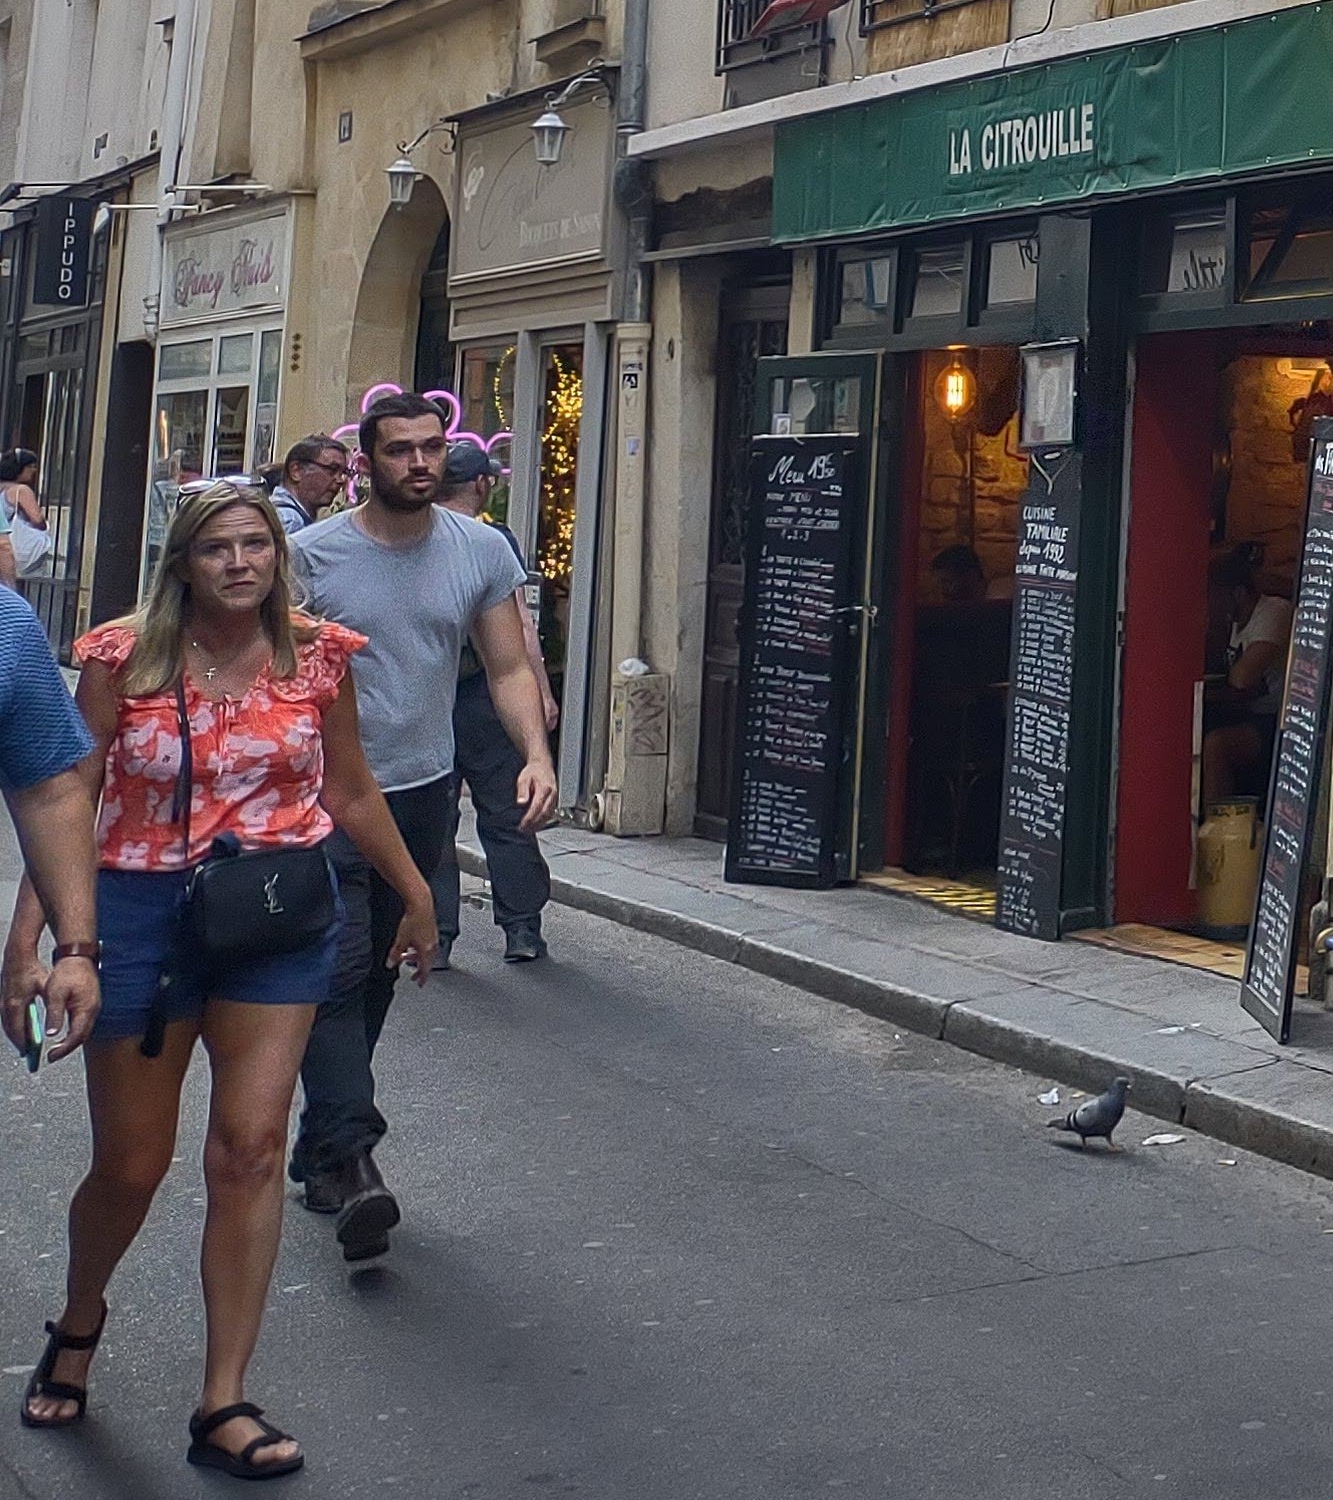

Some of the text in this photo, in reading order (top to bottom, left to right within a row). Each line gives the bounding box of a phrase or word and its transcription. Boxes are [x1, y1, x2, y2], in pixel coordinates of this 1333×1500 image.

[950, 102, 1093, 174] LA CITROUILLE
[58, 201, 74, 298] IPPUDO
